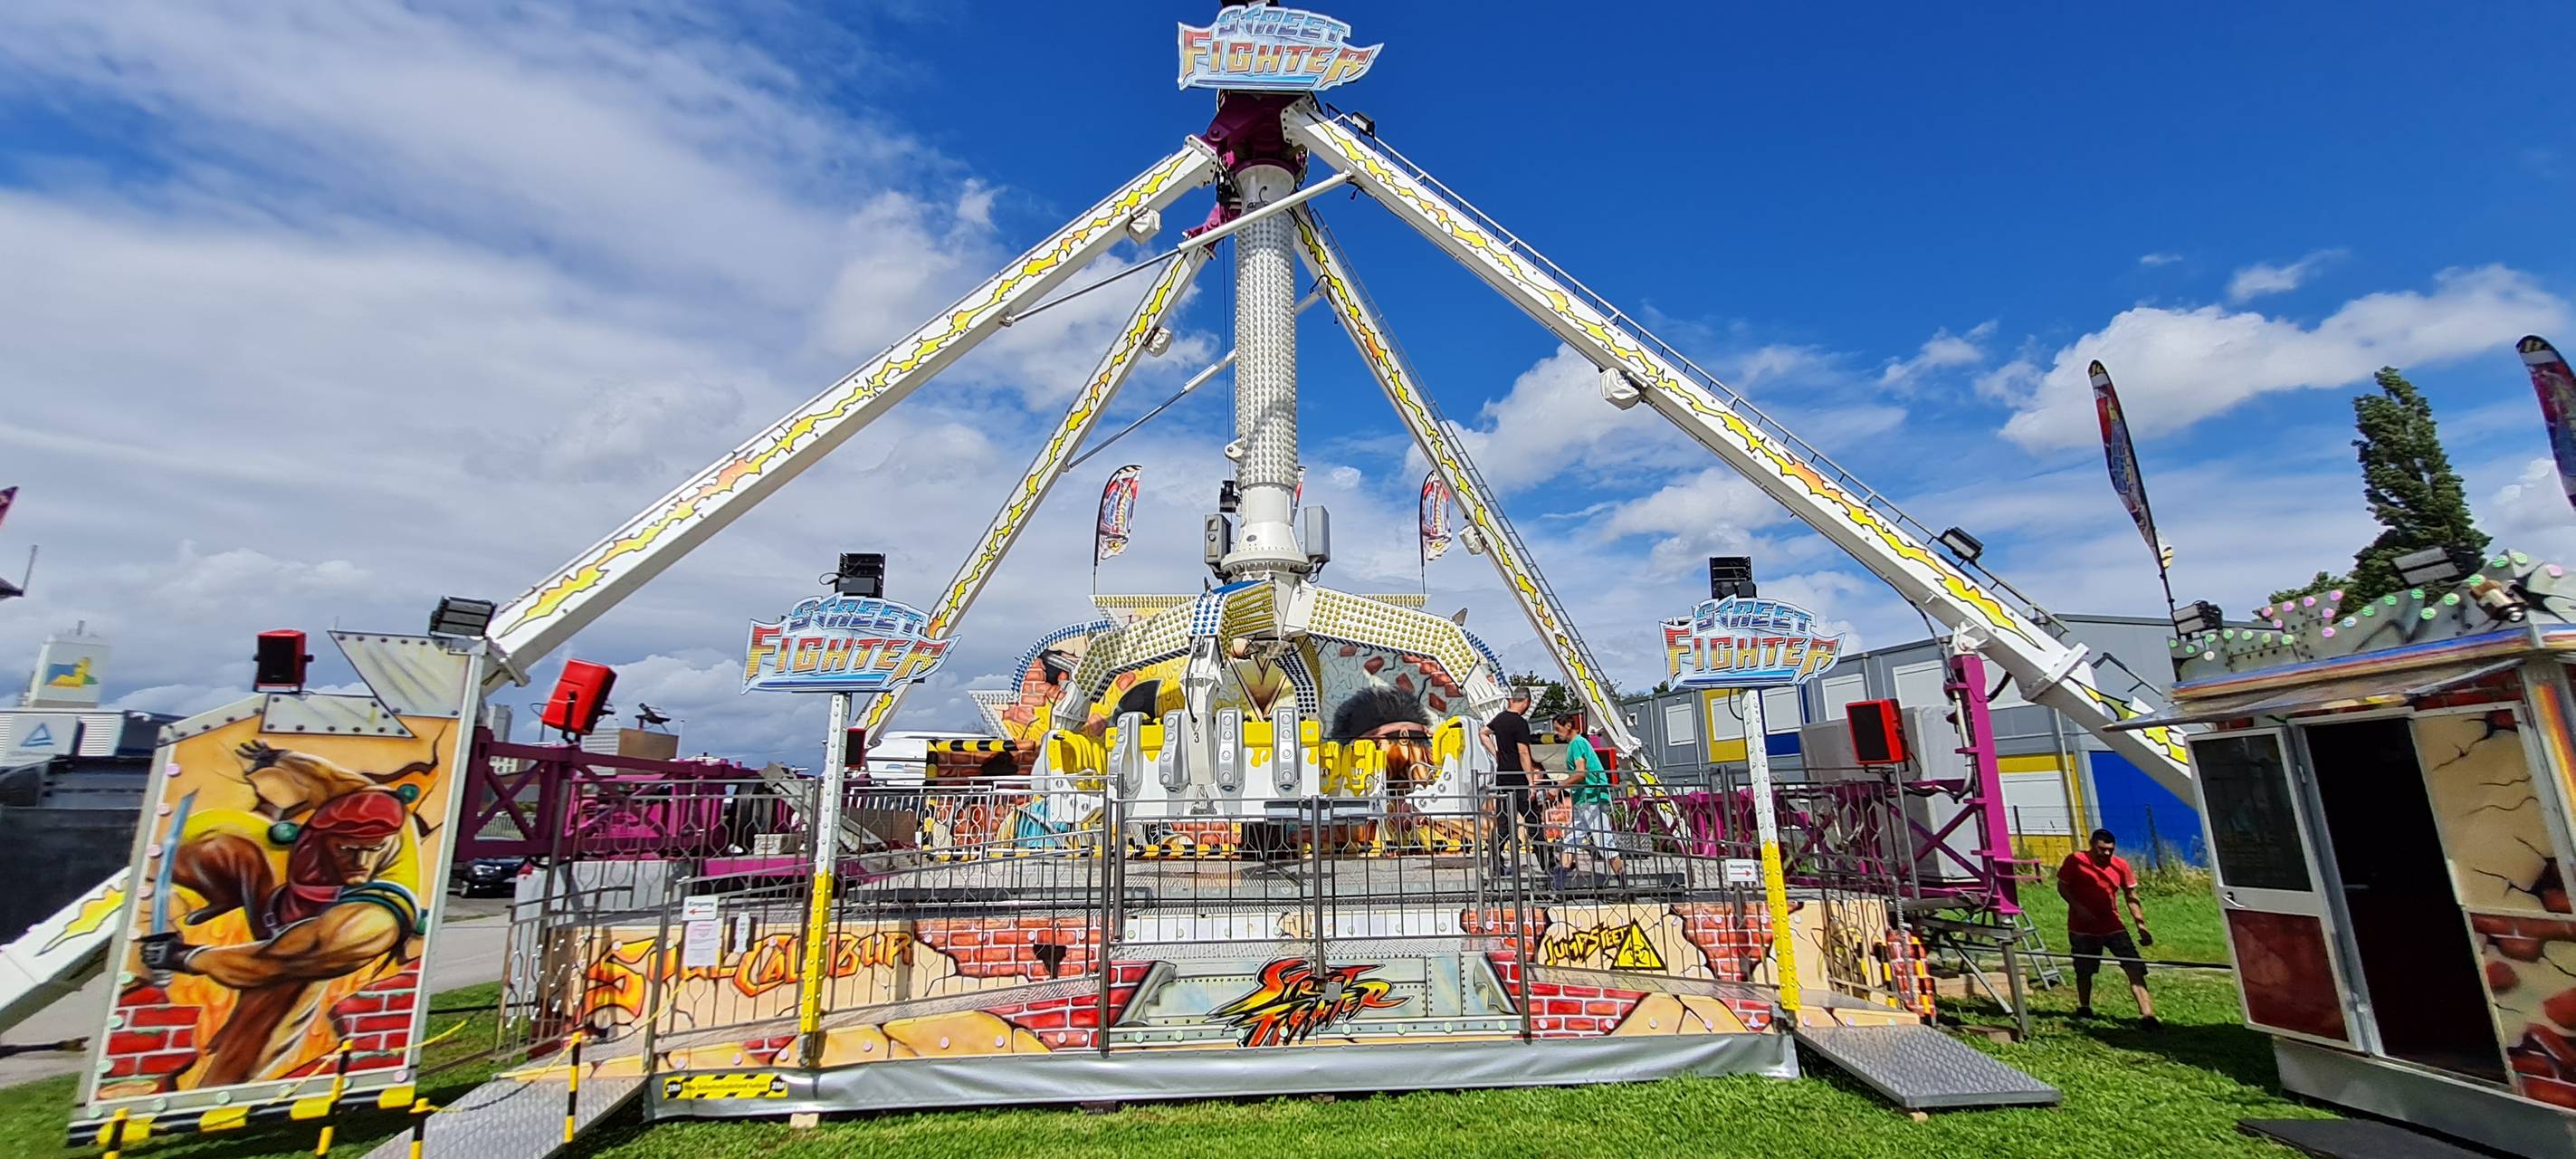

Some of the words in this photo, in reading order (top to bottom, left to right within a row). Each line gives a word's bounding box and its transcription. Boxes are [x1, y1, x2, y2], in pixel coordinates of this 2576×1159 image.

[1218, 7, 1346, 43] STREET
[1181, 29, 1374, 88] FIGHTER
[787, 597, 923, 634] STREET
[1695, 599, 1811, 632] STREET
[745, 625, 950, 685] FIGHTER
[1664, 627, 1839, 685] FIGHTER
[1193, 732, 1200, 743] 3
